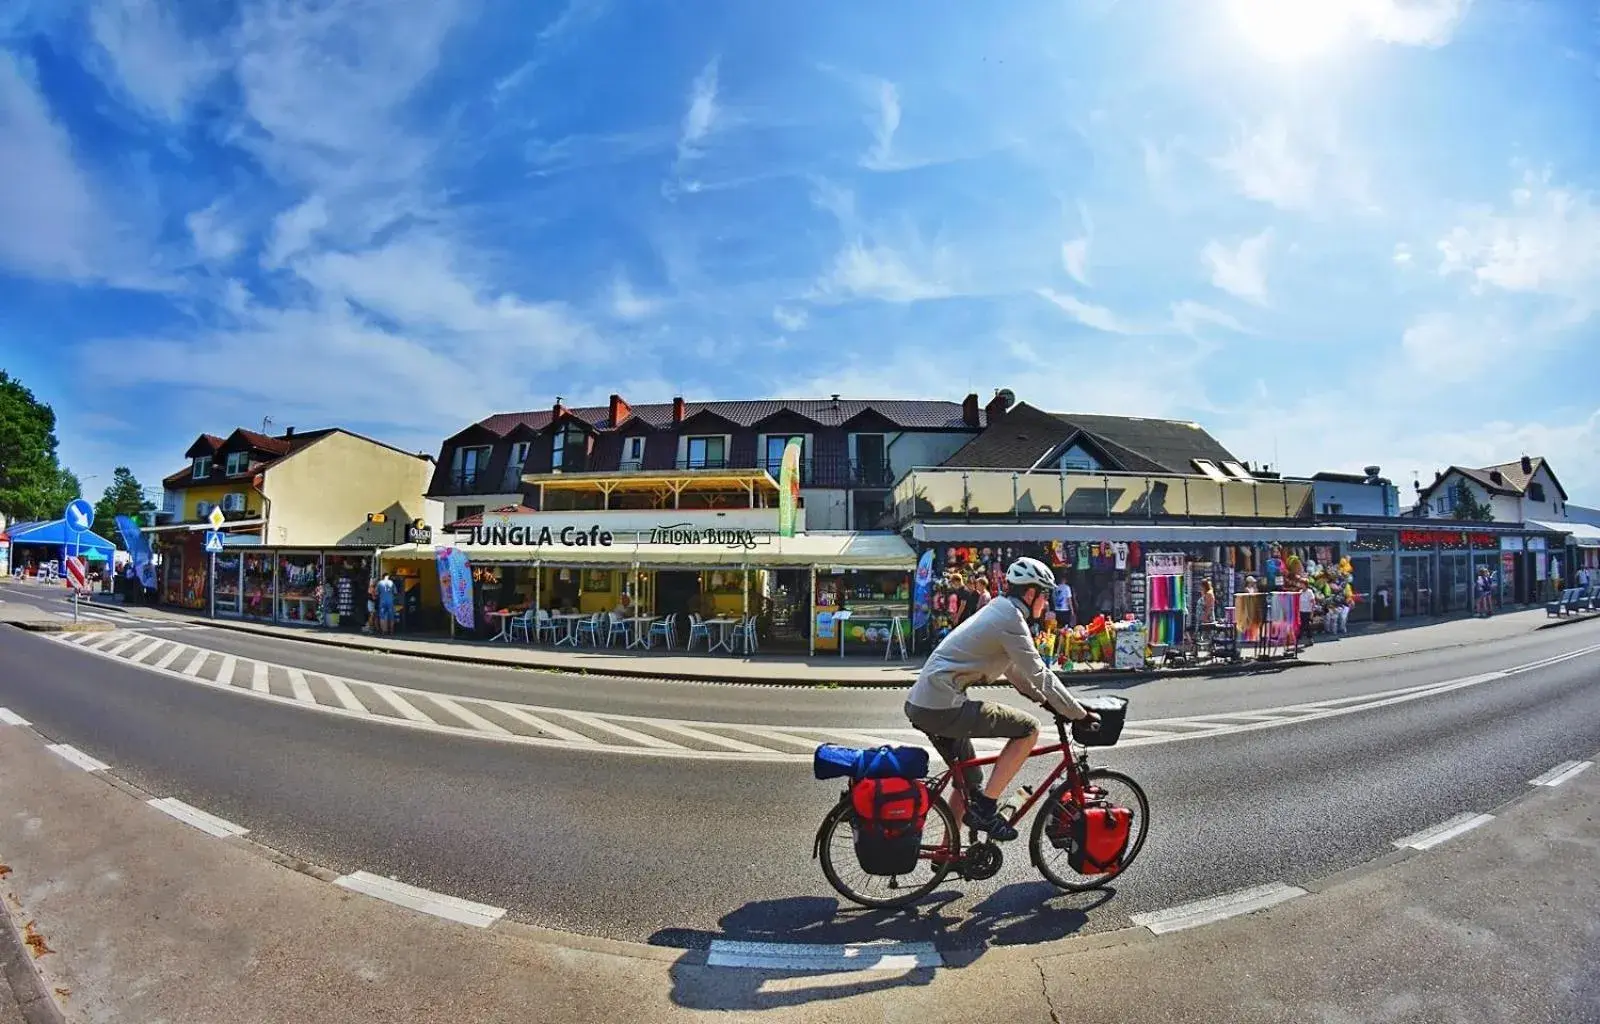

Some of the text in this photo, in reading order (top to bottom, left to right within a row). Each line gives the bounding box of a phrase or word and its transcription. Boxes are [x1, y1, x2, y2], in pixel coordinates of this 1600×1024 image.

[466, 525, 613, 546] JUNGLA Cafe
[650, 527, 757, 549] ZIELONA BUDKA
